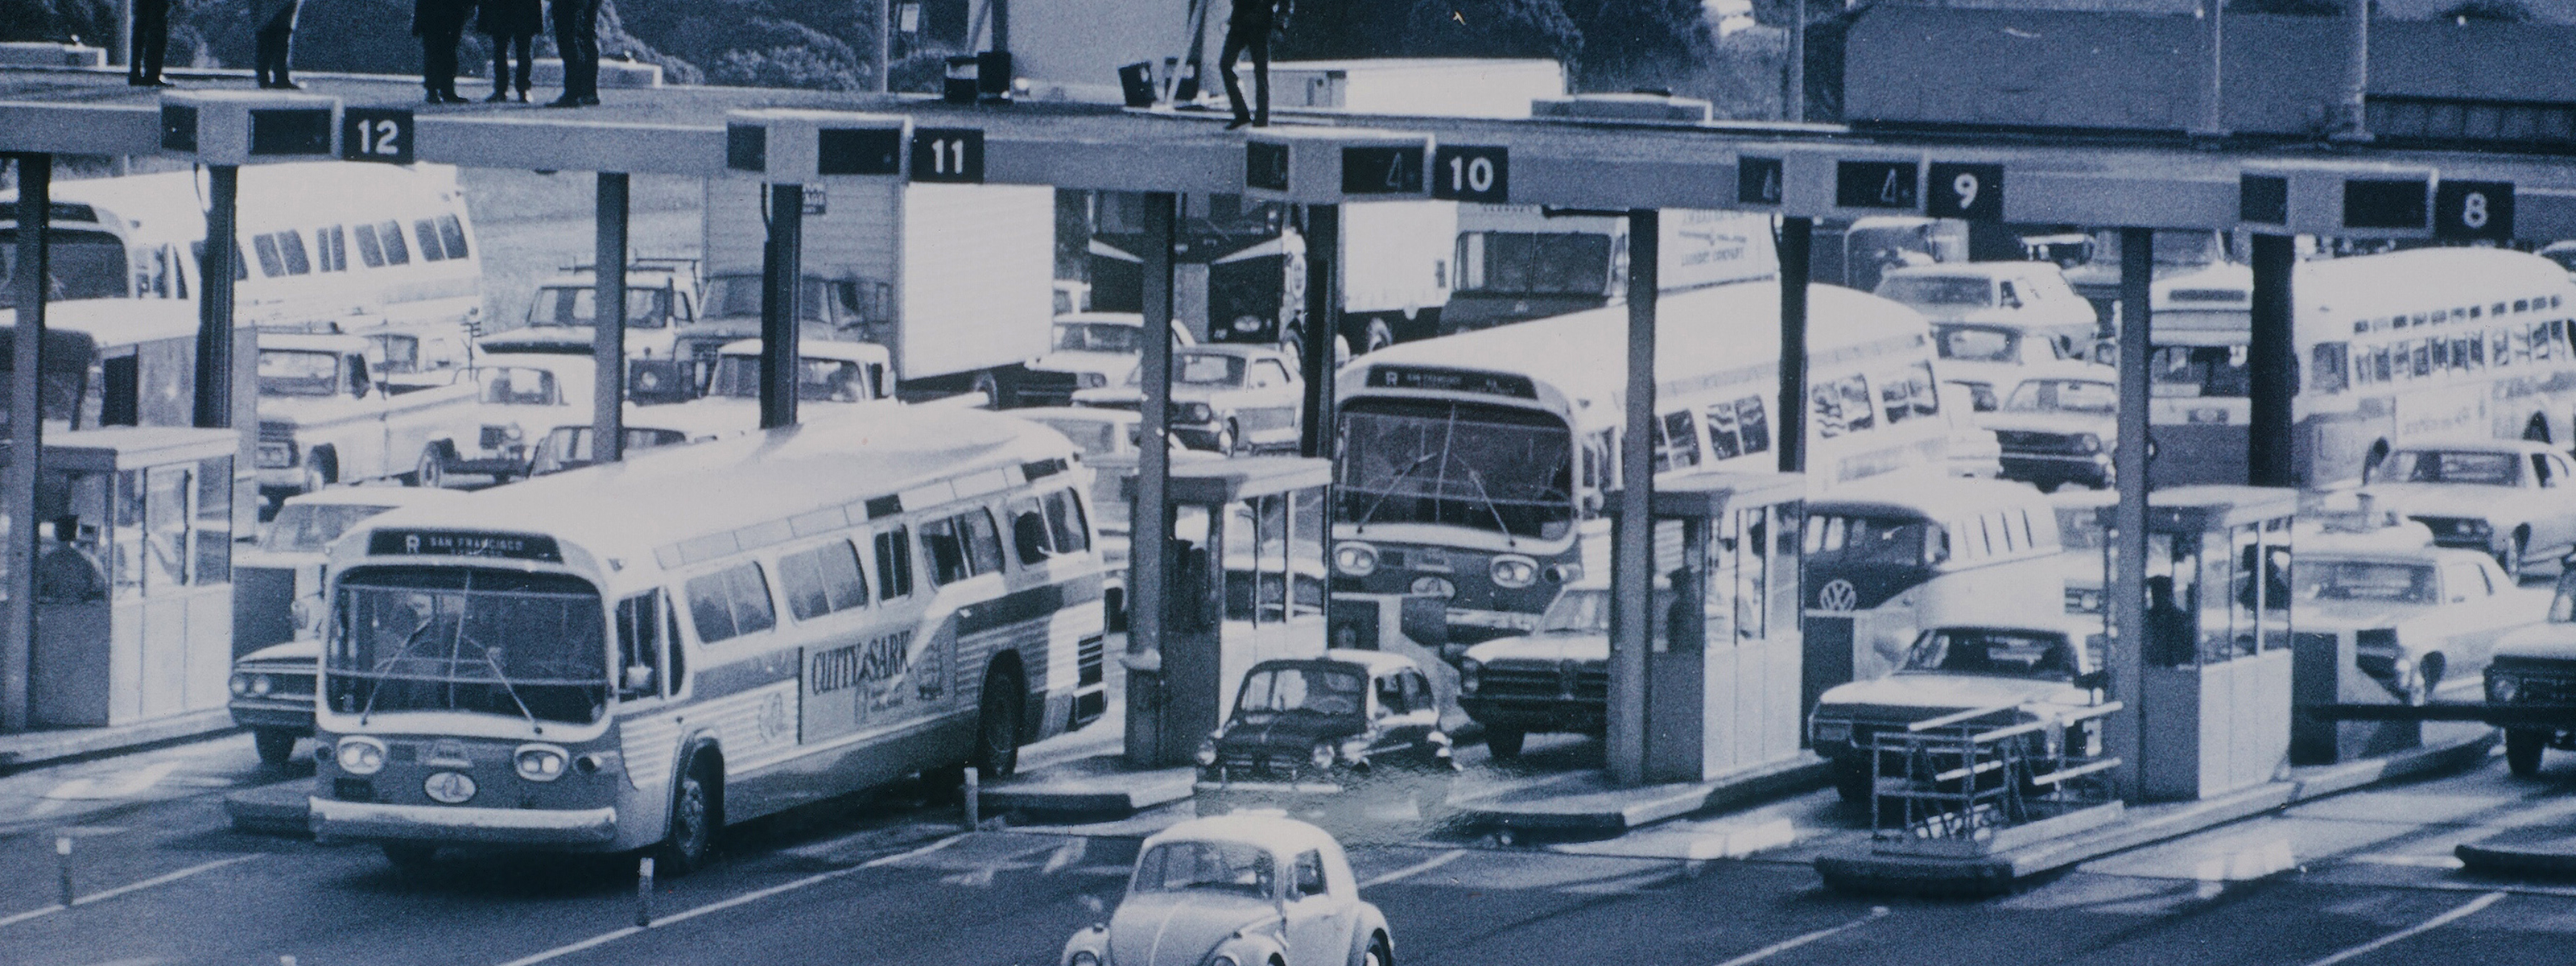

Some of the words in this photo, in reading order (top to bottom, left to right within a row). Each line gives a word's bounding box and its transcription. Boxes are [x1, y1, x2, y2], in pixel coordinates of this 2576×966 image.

[358, 119, 398, 154] 12
[932, 138, 963, 174] 11
[1451, 156, 1493, 192] 10
[1954, 173, 1978, 208] 9
[2464, 192, 2487, 229] 8
[1385, 371, 1398, 386] R
[405, 535, 420, 554] R
[430, 536, 453, 547] SAN
[811, 643, 864, 696] CUTTY
[868, 630, 911, 682] SARK
